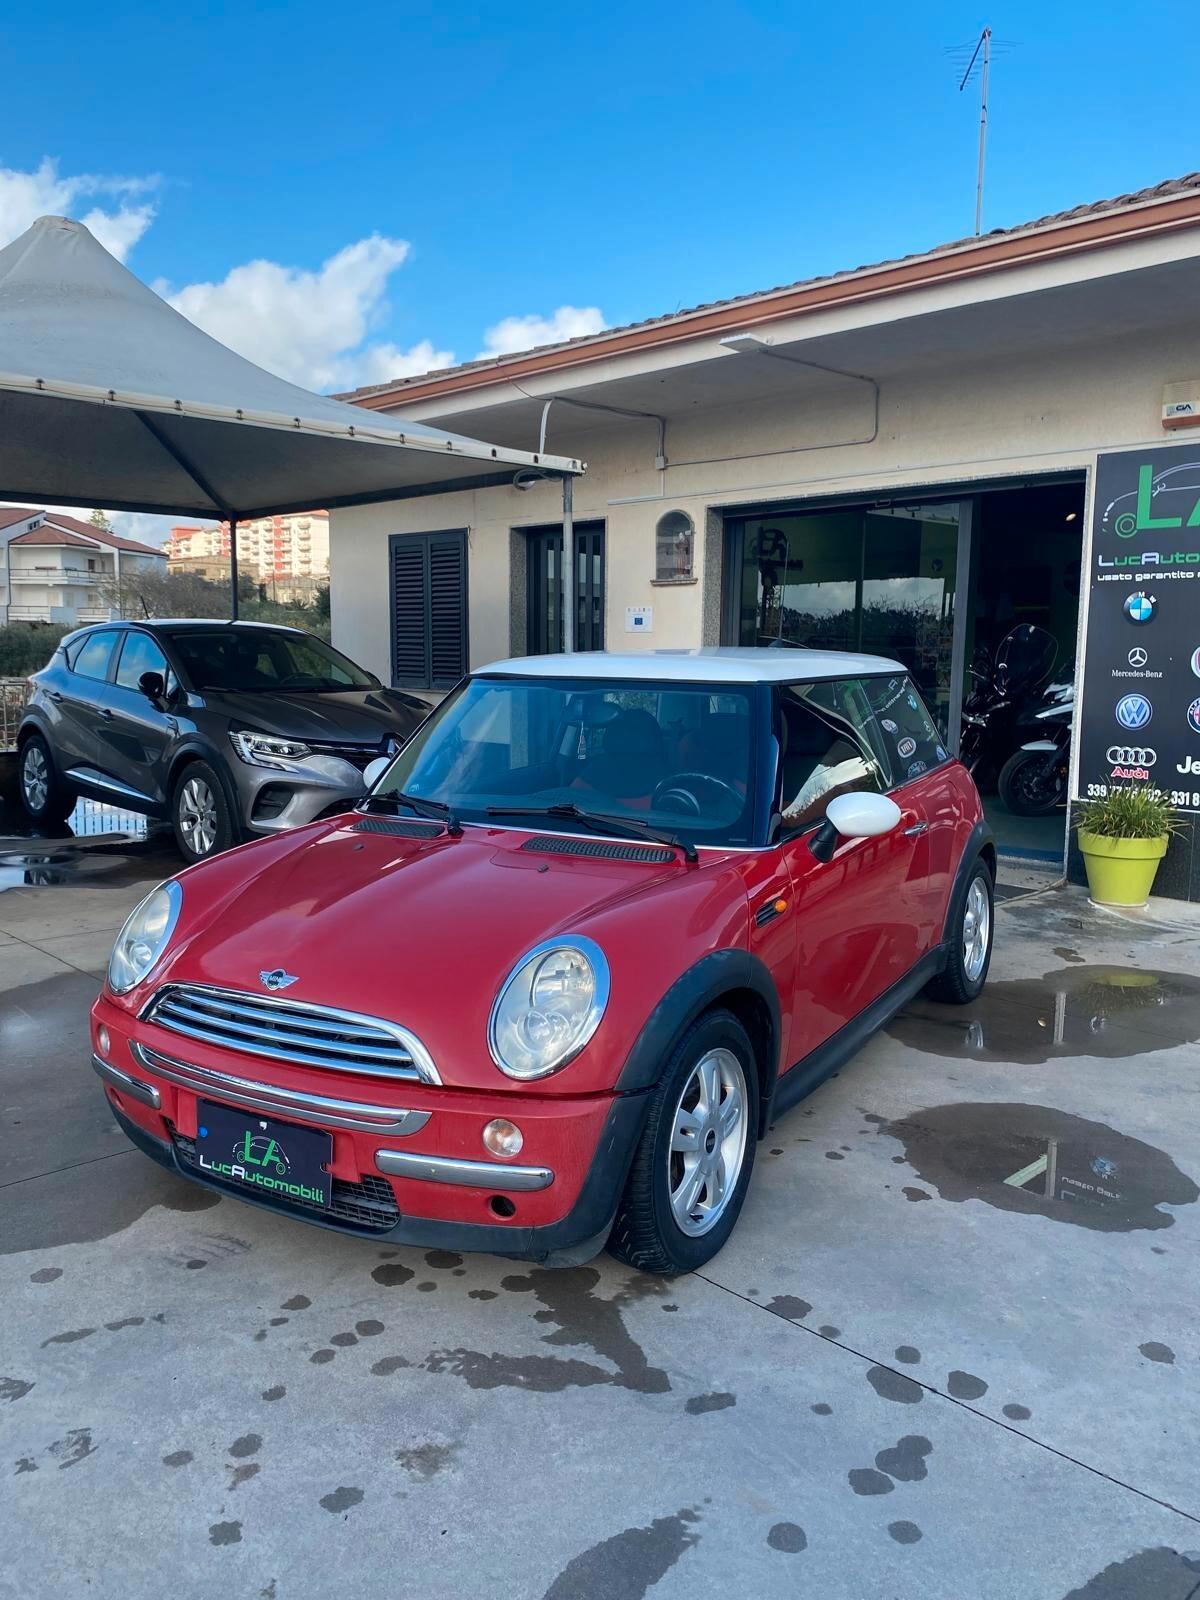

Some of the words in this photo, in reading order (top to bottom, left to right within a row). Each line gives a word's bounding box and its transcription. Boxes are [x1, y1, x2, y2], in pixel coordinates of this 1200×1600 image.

[1136, 465, 1200, 530] L
[1097, 573, 1132, 581] usato
[1135, 571, 1194, 582] garantito
[1111, 669, 1163, 678] Mercedes-Benz
[1110, 766, 1149, 780] Audi
[1176, 756, 1200, 775] Je
[1087, 783, 1107, 797] 339
[1171, 790, 1190, 806] 331
[244, 1131, 281, 1166] LA
[199, 1154, 324, 1203] LucAutomobili
